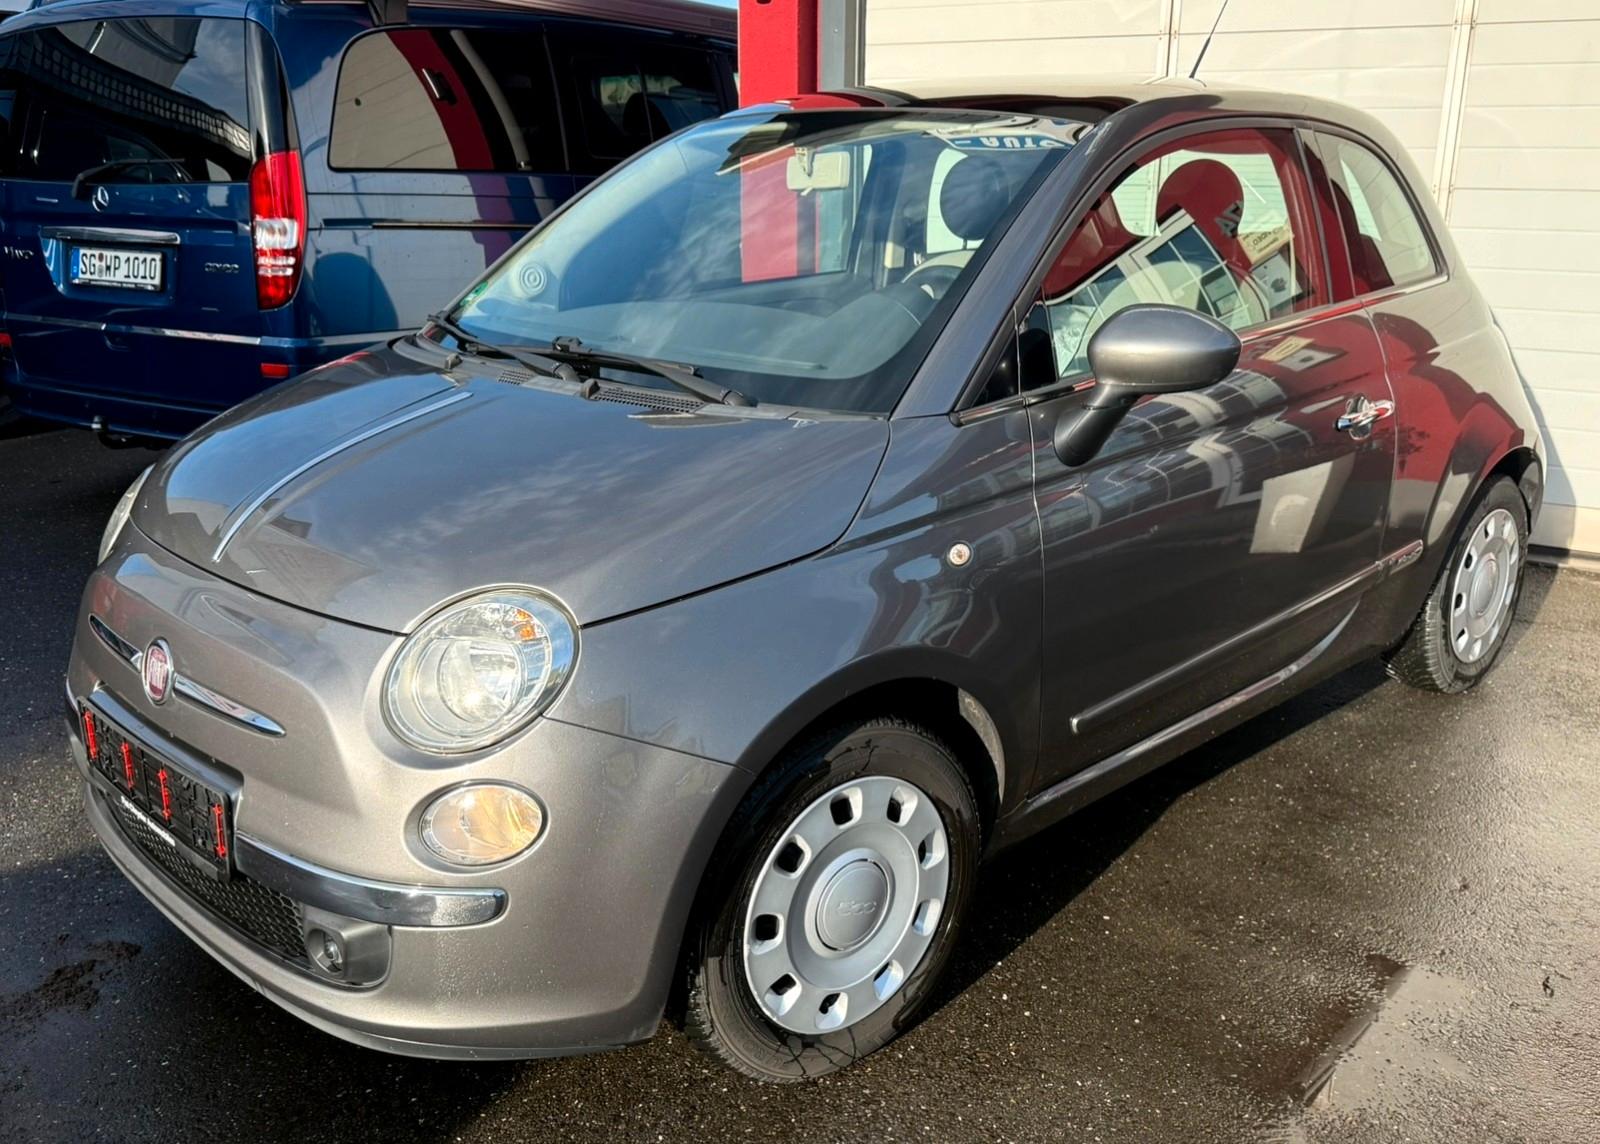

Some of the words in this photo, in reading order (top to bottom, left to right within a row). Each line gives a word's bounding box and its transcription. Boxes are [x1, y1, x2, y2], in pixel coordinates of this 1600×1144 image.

[80, 252, 97, 276] SG
[104, 254, 121, 279] WP
[123, 256, 157, 280] 1010
